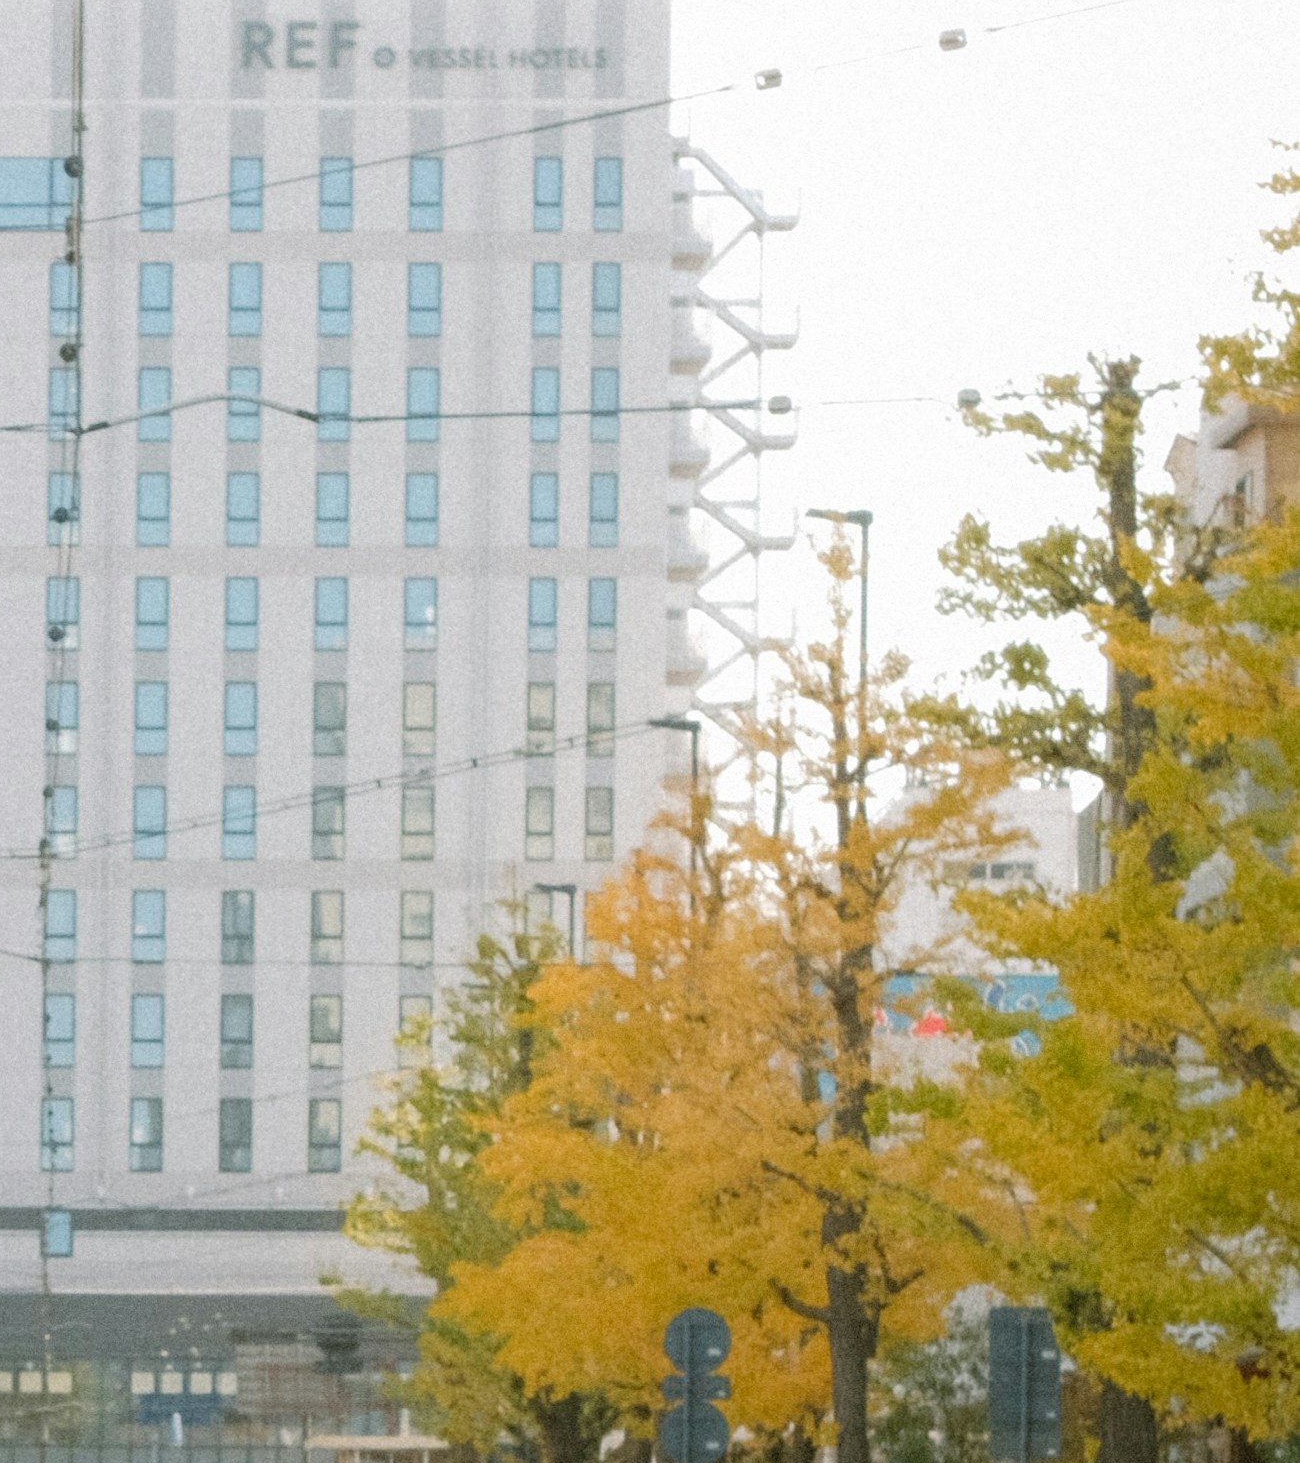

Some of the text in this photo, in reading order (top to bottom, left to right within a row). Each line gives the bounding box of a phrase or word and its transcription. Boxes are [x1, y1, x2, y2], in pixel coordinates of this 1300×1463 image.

[240, 20, 607, 69] REF VESSEL HOTELS
